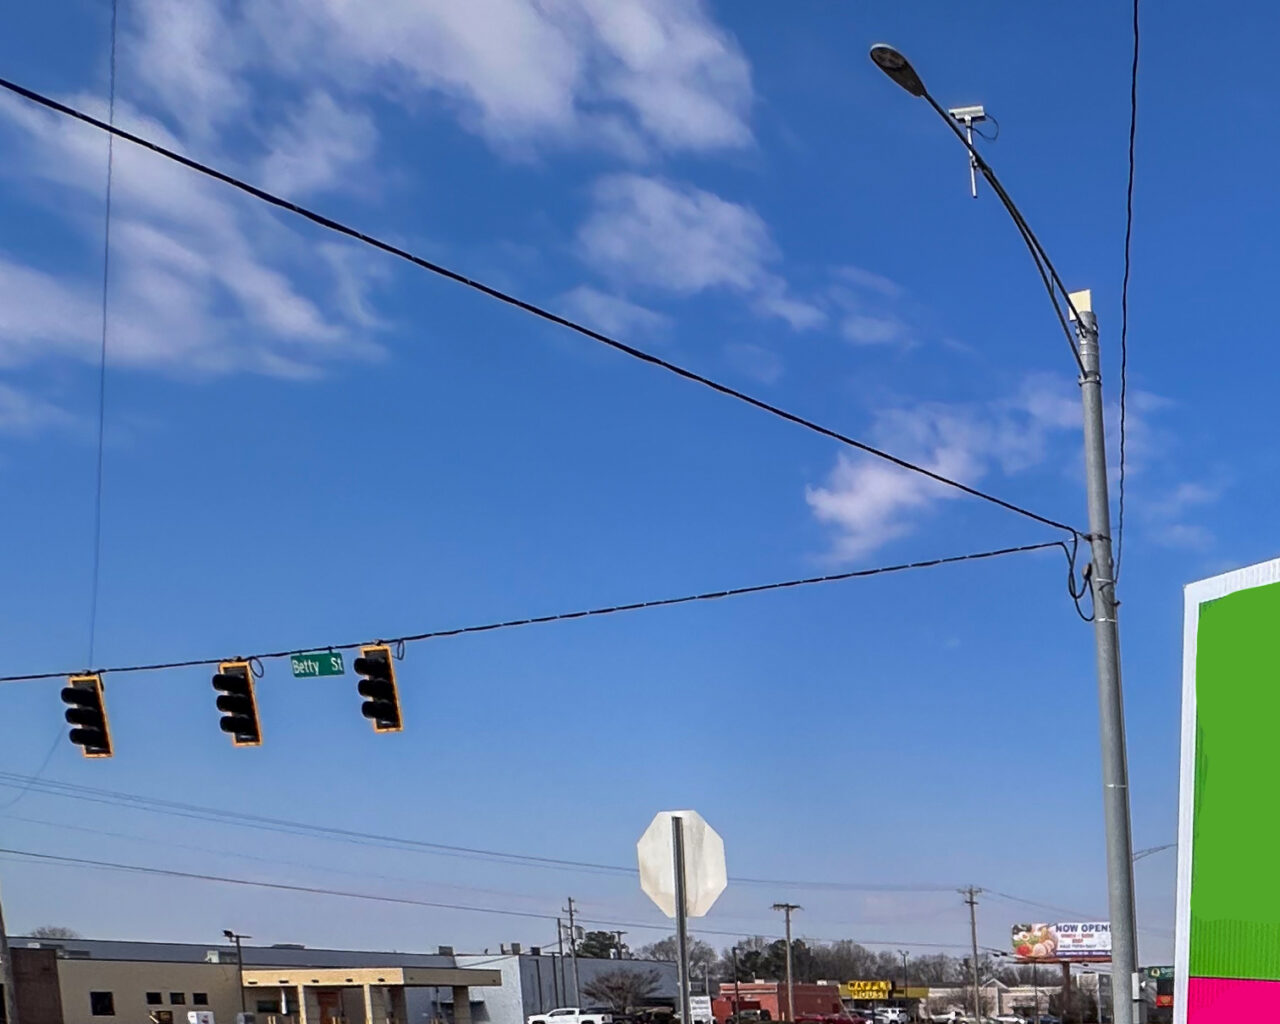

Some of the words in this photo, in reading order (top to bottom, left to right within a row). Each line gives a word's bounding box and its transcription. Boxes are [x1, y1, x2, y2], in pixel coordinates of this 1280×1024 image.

[292, 659, 319, 675] Betty
[330, 657, 343, 671] St
[1055, 924, 1078, 932] NOW
